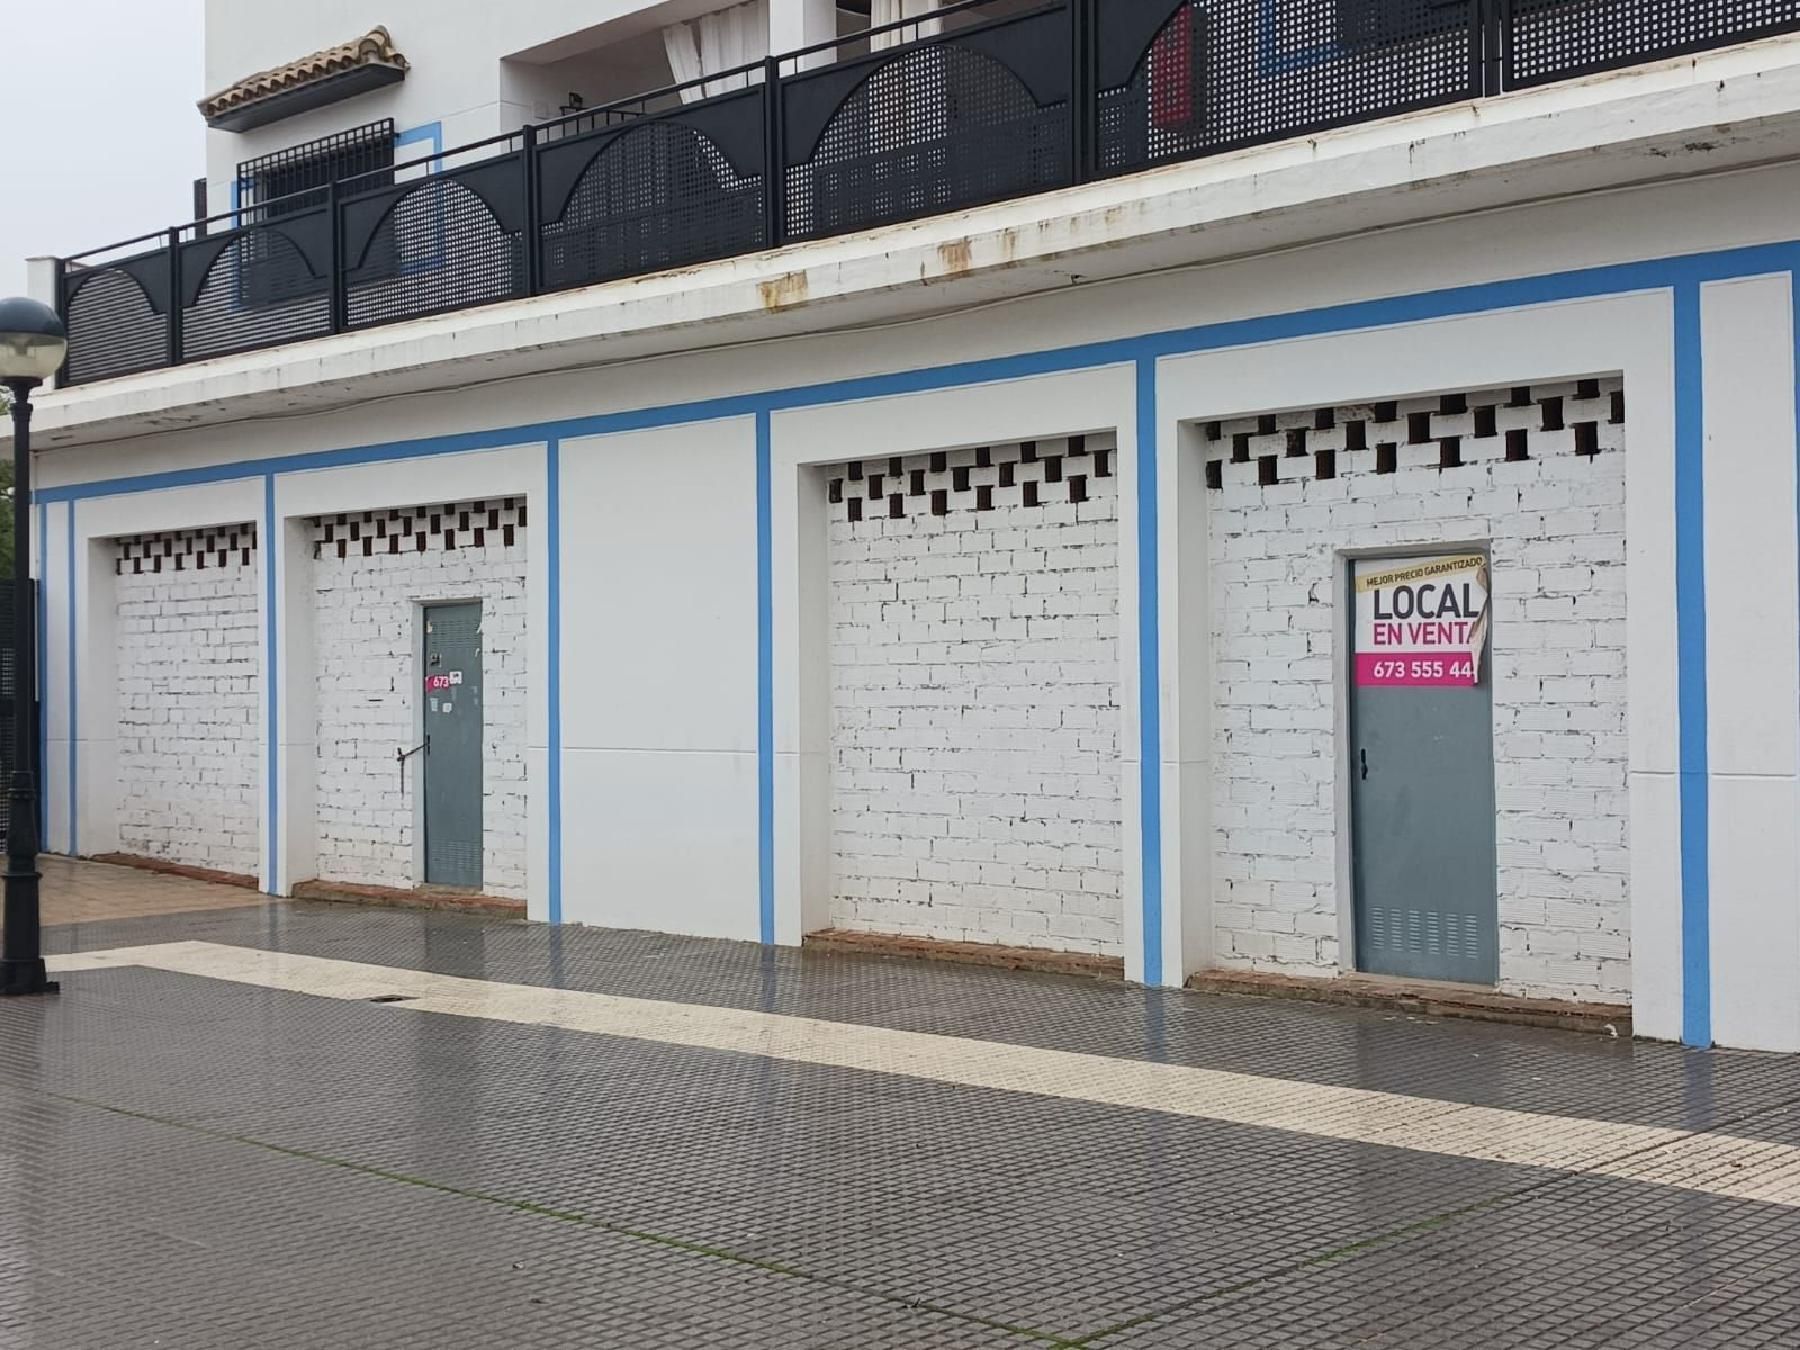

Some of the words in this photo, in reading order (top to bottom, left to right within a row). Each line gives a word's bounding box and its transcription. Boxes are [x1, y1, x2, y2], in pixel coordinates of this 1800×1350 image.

[1366, 574, 1394, 586] MEJOR
[1394, 568, 1423, 582] PRECIO
[1424, 557, 1483, 576] GARANTIZADO
[1374, 583, 1479, 620] LOCAL
[1373, 622, 1402, 645] EN
[1374, 661, 1405, 678] 673
[1411, 661, 1443, 678] 555
[433, 676, 449, 687] 673
